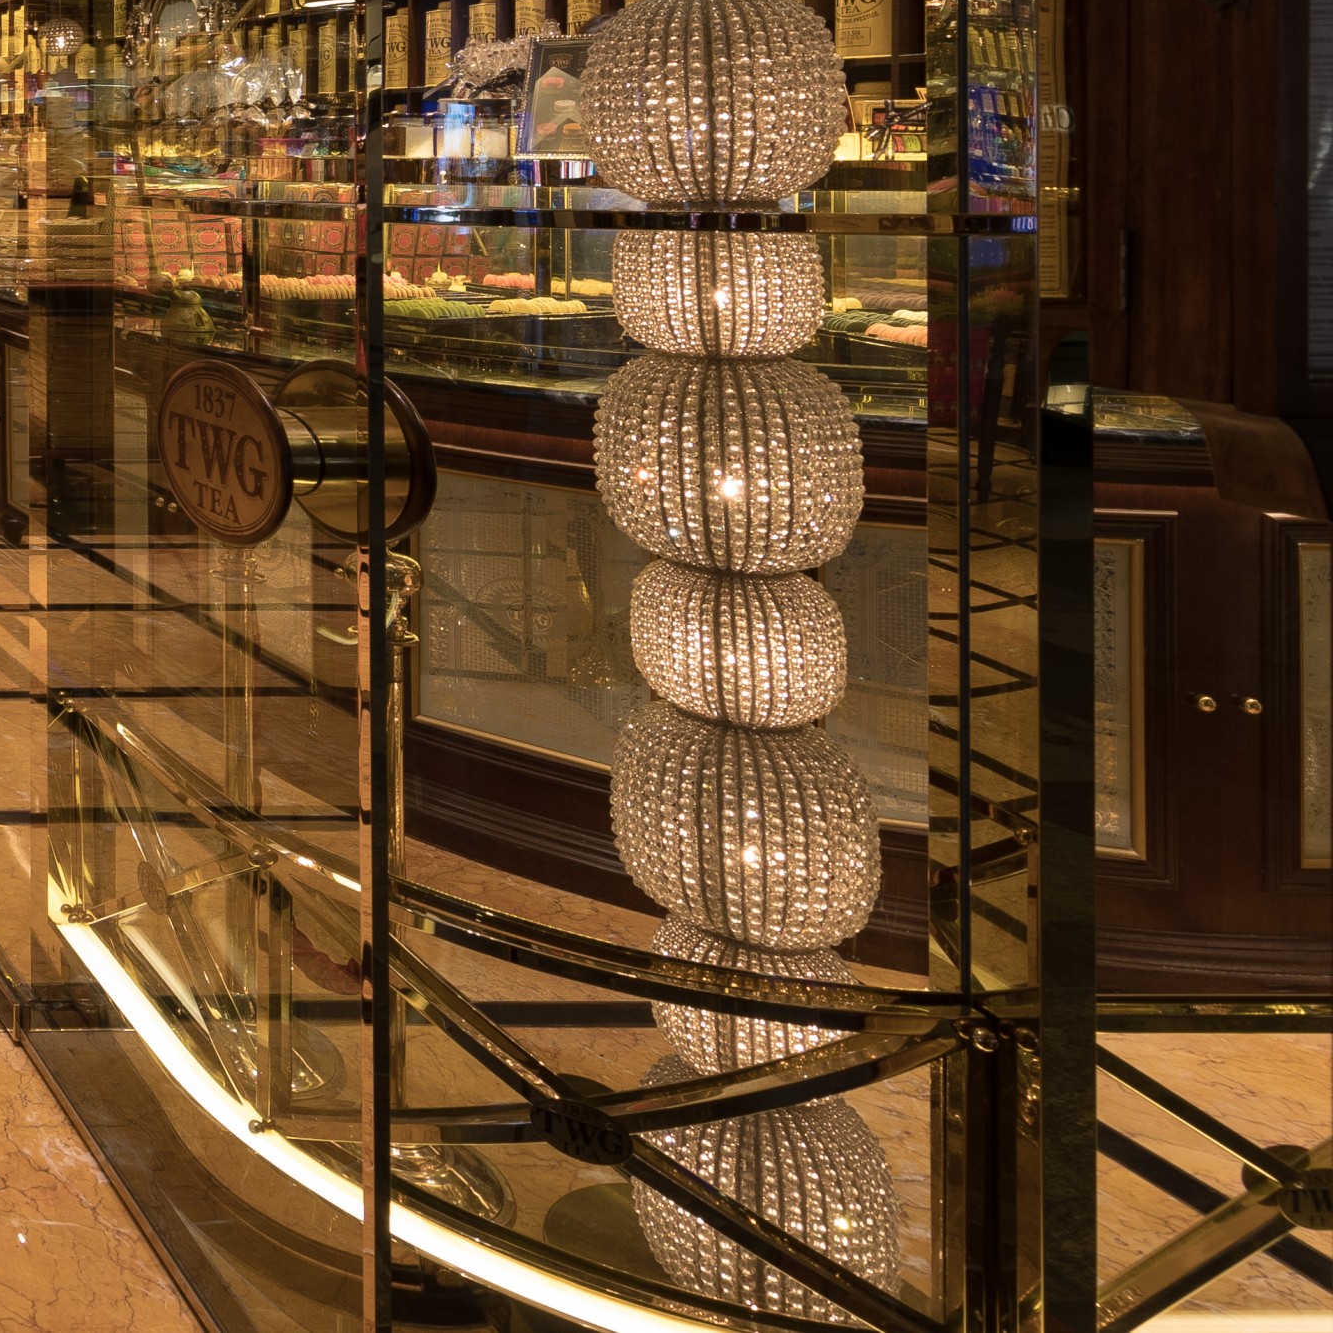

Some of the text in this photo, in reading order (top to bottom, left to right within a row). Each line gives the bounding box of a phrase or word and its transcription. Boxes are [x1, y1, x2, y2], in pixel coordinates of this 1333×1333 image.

[840, 6, 861, 14] TEA
[193, 382, 237, 421] 1837
[168, 410, 268, 502] TWG
[192, 478, 240, 525] TEA
